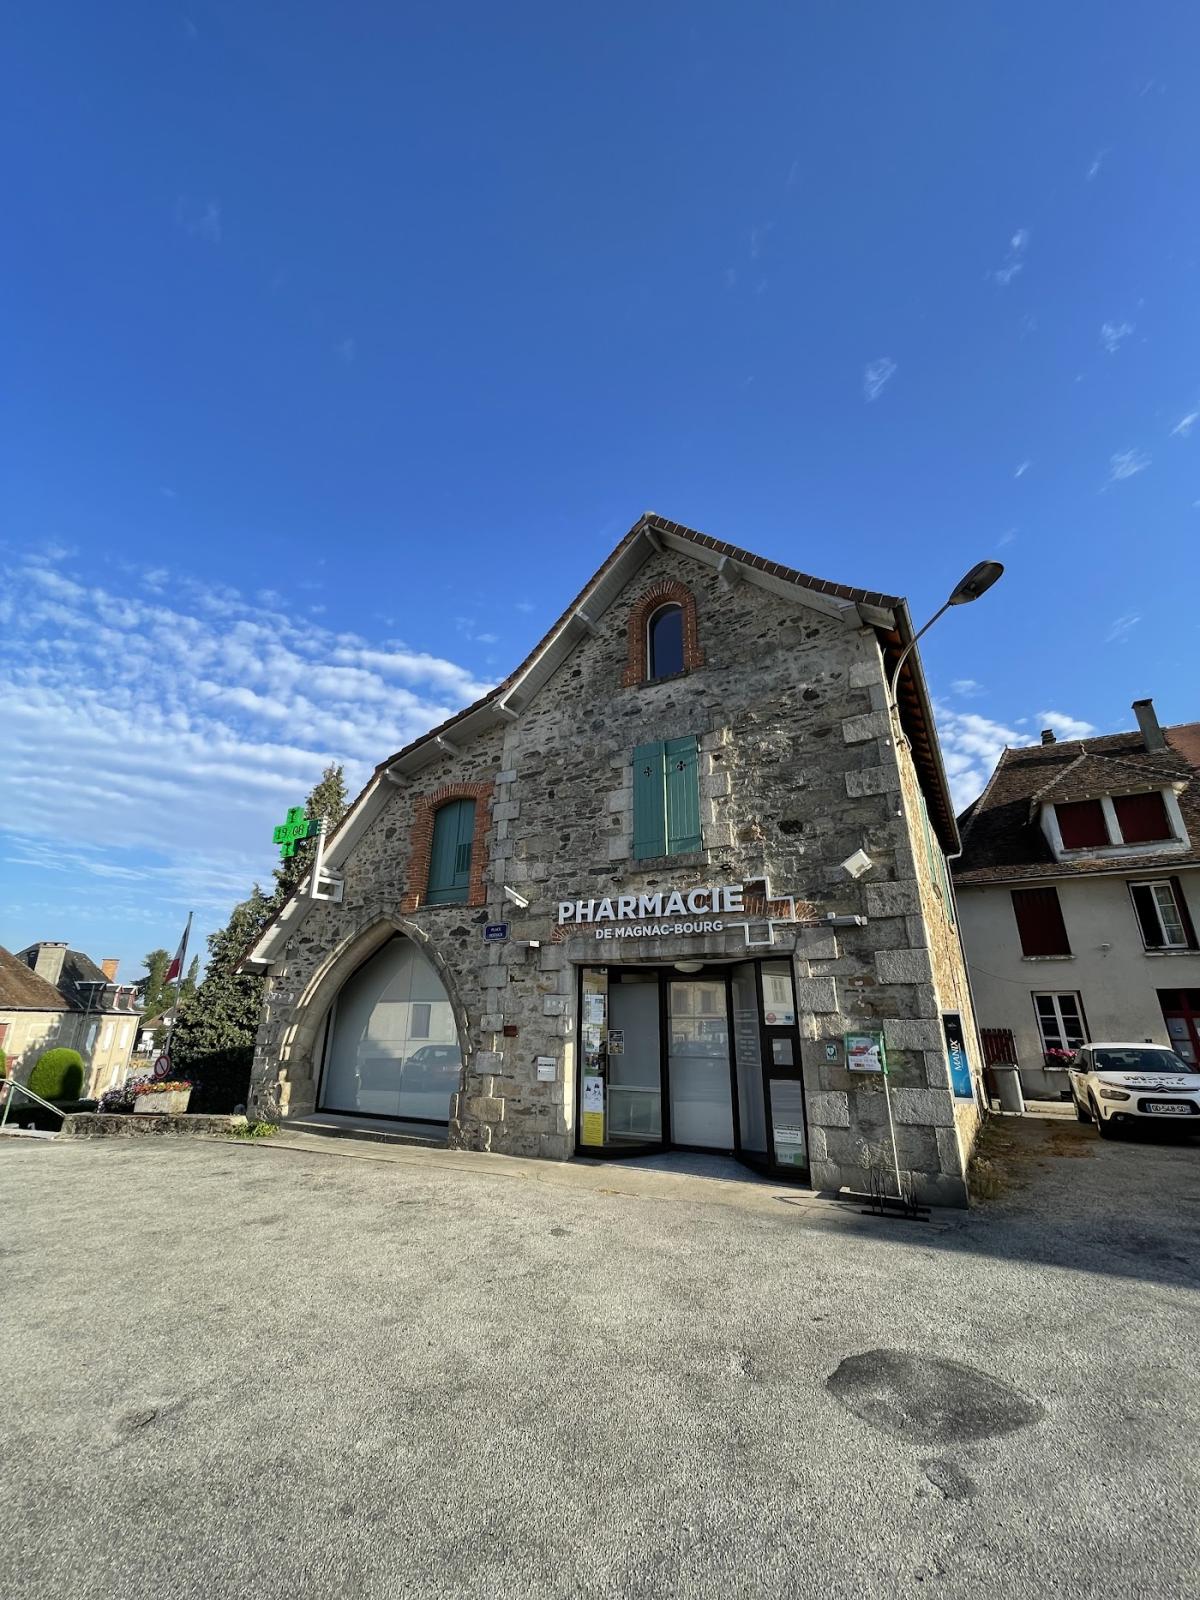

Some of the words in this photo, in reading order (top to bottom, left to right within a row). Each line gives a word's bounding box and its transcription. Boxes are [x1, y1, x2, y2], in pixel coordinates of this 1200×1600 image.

[558, 884, 745, 925] PHARMACIE
[595, 928, 612, 940] DE
[615, 920, 723, 938] MAGNAC-BOURG
[949, 1038, 962, 1071] MANIX
